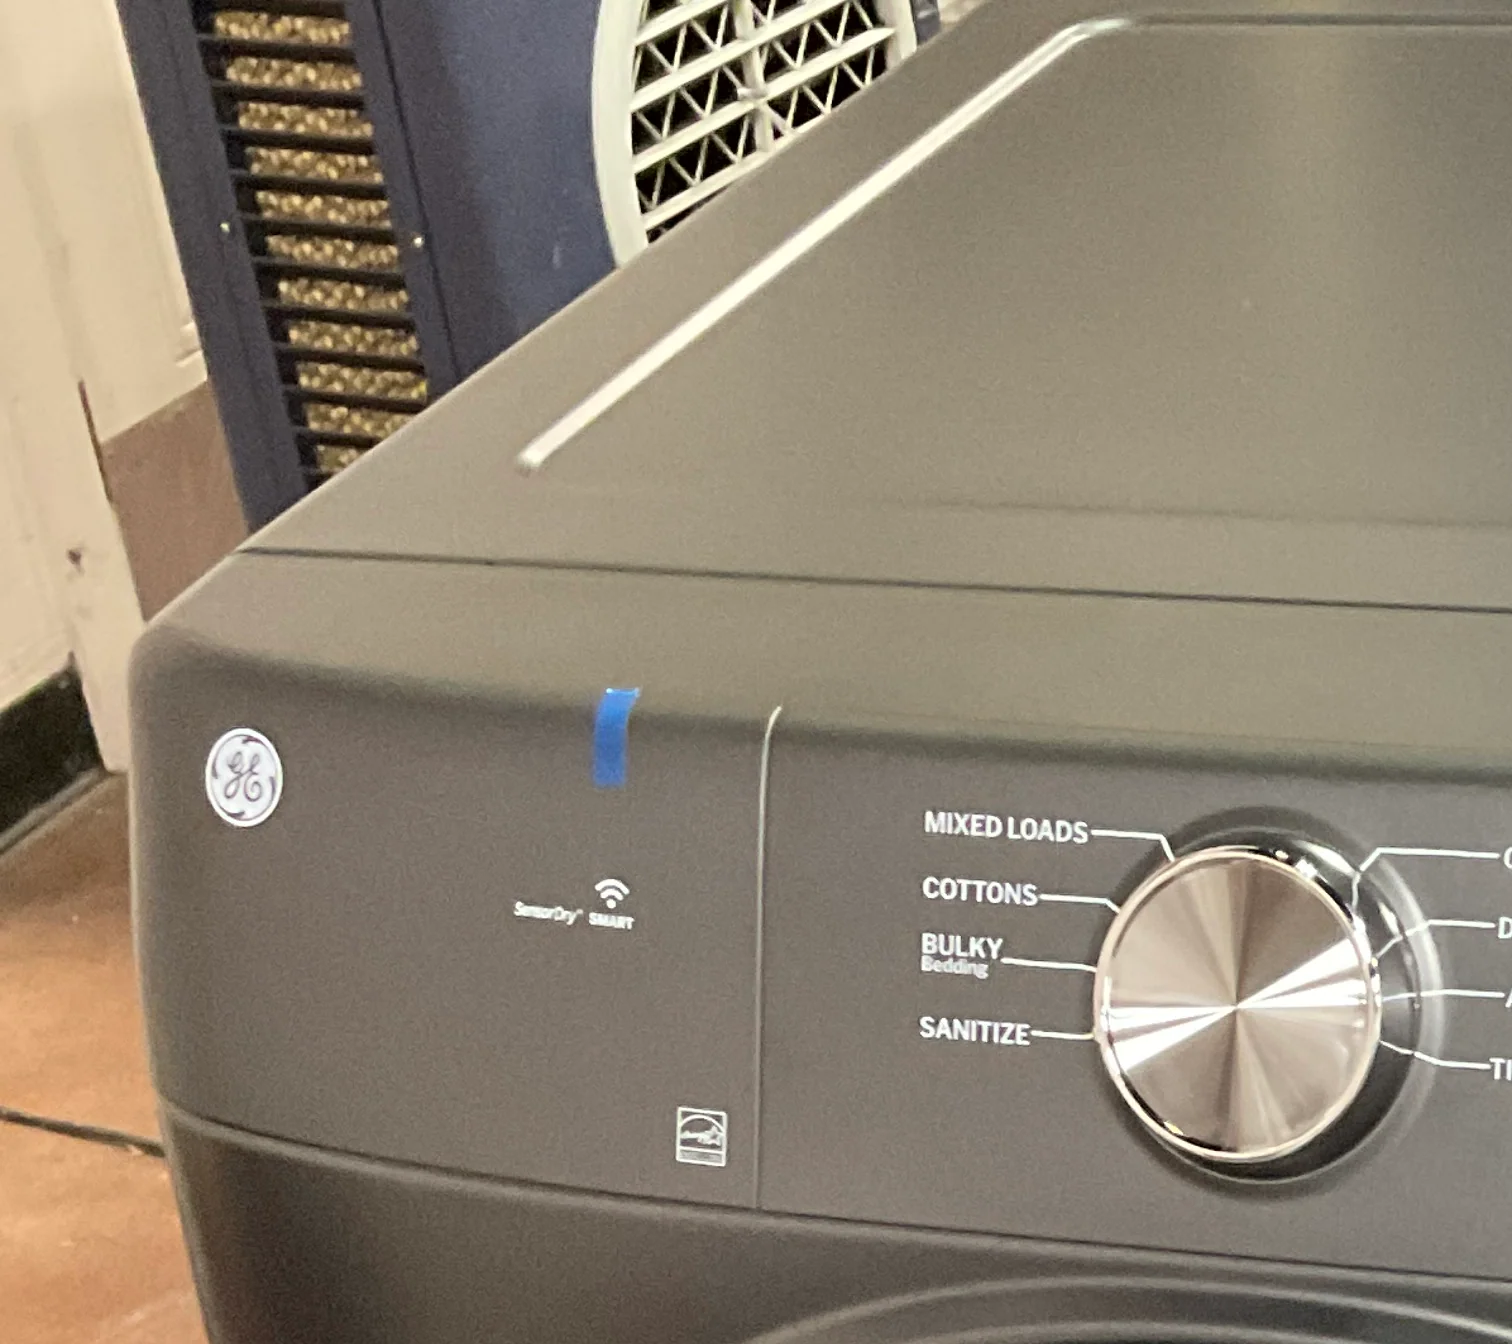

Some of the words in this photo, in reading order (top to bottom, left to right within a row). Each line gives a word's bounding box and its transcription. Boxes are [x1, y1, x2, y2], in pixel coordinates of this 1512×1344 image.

[924, 810, 1003, 838] MIXED
[1006, 816, 1089, 844] LOADS
[922, 876, 1039, 906] COTTONS
[921, 932, 1003, 960] BULKY
[920, 955, 989, 980] Bedding
[919, 1016, 1031, 1046] SANITIZE
